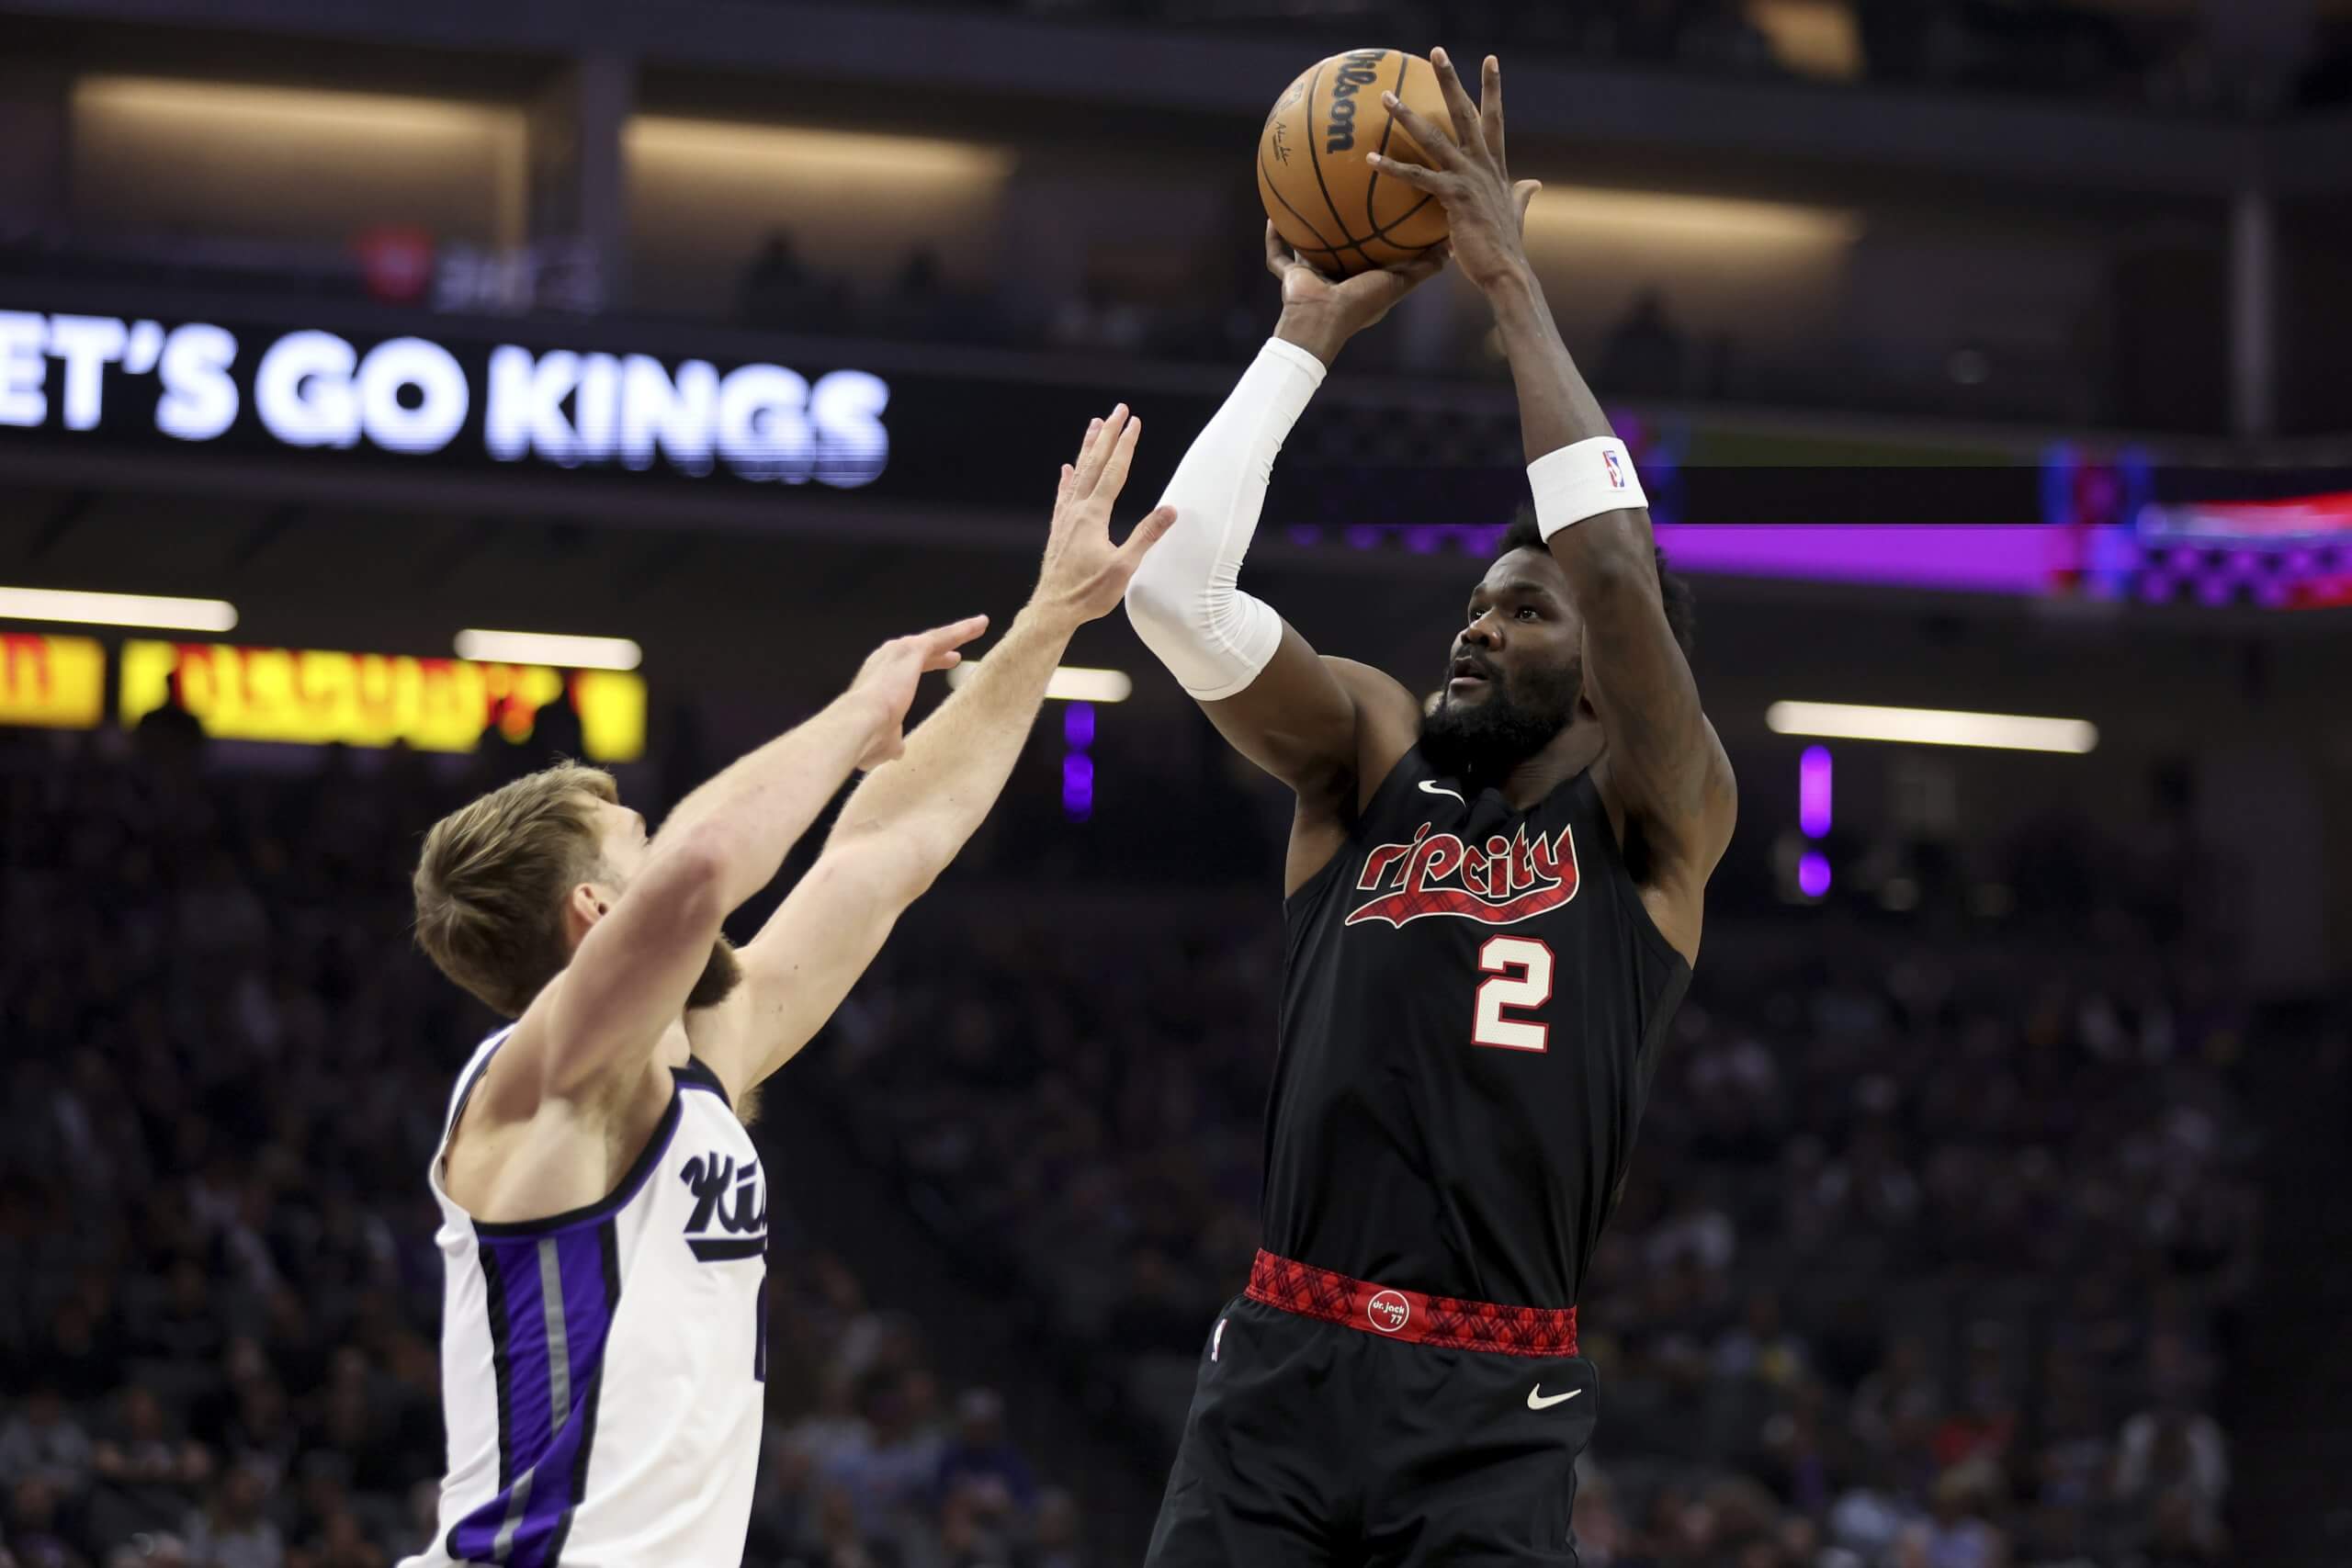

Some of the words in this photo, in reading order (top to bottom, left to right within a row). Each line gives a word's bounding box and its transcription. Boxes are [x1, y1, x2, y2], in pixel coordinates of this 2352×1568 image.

[254, 330, 469, 454] GO
[485, 344, 889, 488] KINGS
[1470, 933, 1555, 1054] 2
[680, 1150, 767, 1235] Ki
[1390, 1314, 1403, 1325] 77
